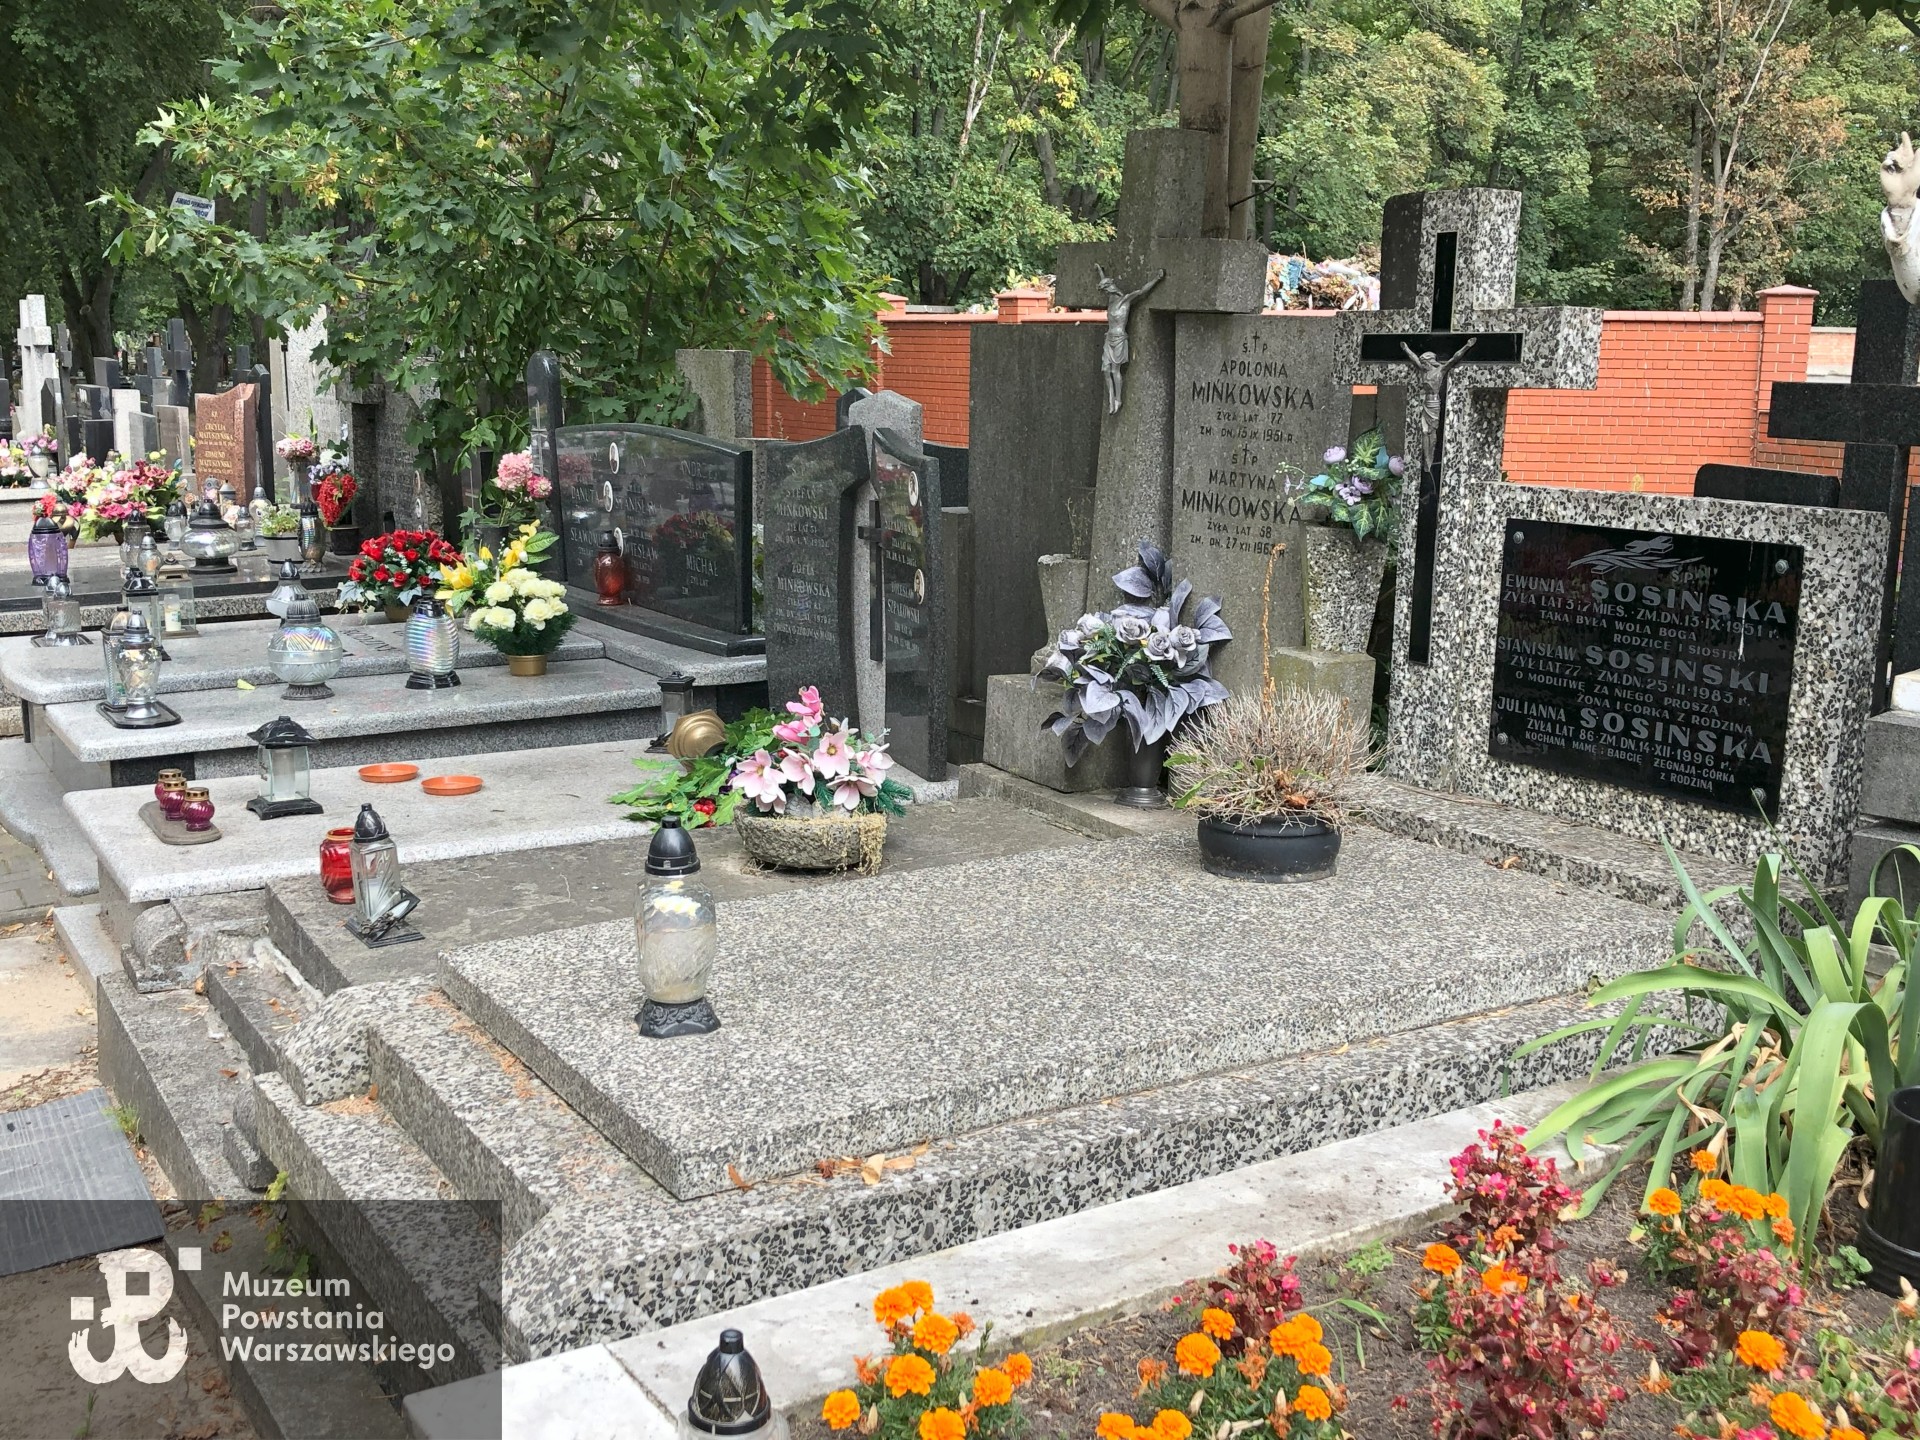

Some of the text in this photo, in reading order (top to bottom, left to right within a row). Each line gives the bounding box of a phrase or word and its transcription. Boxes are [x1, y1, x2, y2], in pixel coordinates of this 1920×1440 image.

[1220, 360, 1288, 379] APOLONIA
[1192, 379, 1315, 410] MIŃKOWSKA
[1208, 468, 1277, 492] MARTYNA
[1182, 489, 1302, 528] MIŃKOWSKA
[1236, 525, 1251, 536] LAT
[1505, 573, 1565, 594] EWUNIA
[1541, 595, 1563, 608] LAT
[1540, 610, 1697, 642] TAKA BYŁA WOLA BOGA
[1497, 636, 1578, 662] STANISŁAW
[1613, 633, 1672, 650] RODZICE
[1688, 645, 1746, 663] SIOSTRA
[1539, 659, 1563, 674] LAT
[1564, 664, 1582, 677] 77
[1515, 670, 1523, 680] O
[1528, 673, 1586, 693] MODLITWĘ
[1593, 684, 1609, 696] ZA
[1614, 688, 1654, 703] NIEGO
[1497, 696, 1567, 722] JULIANNA
[1555, 723, 1576, 738] LAT
